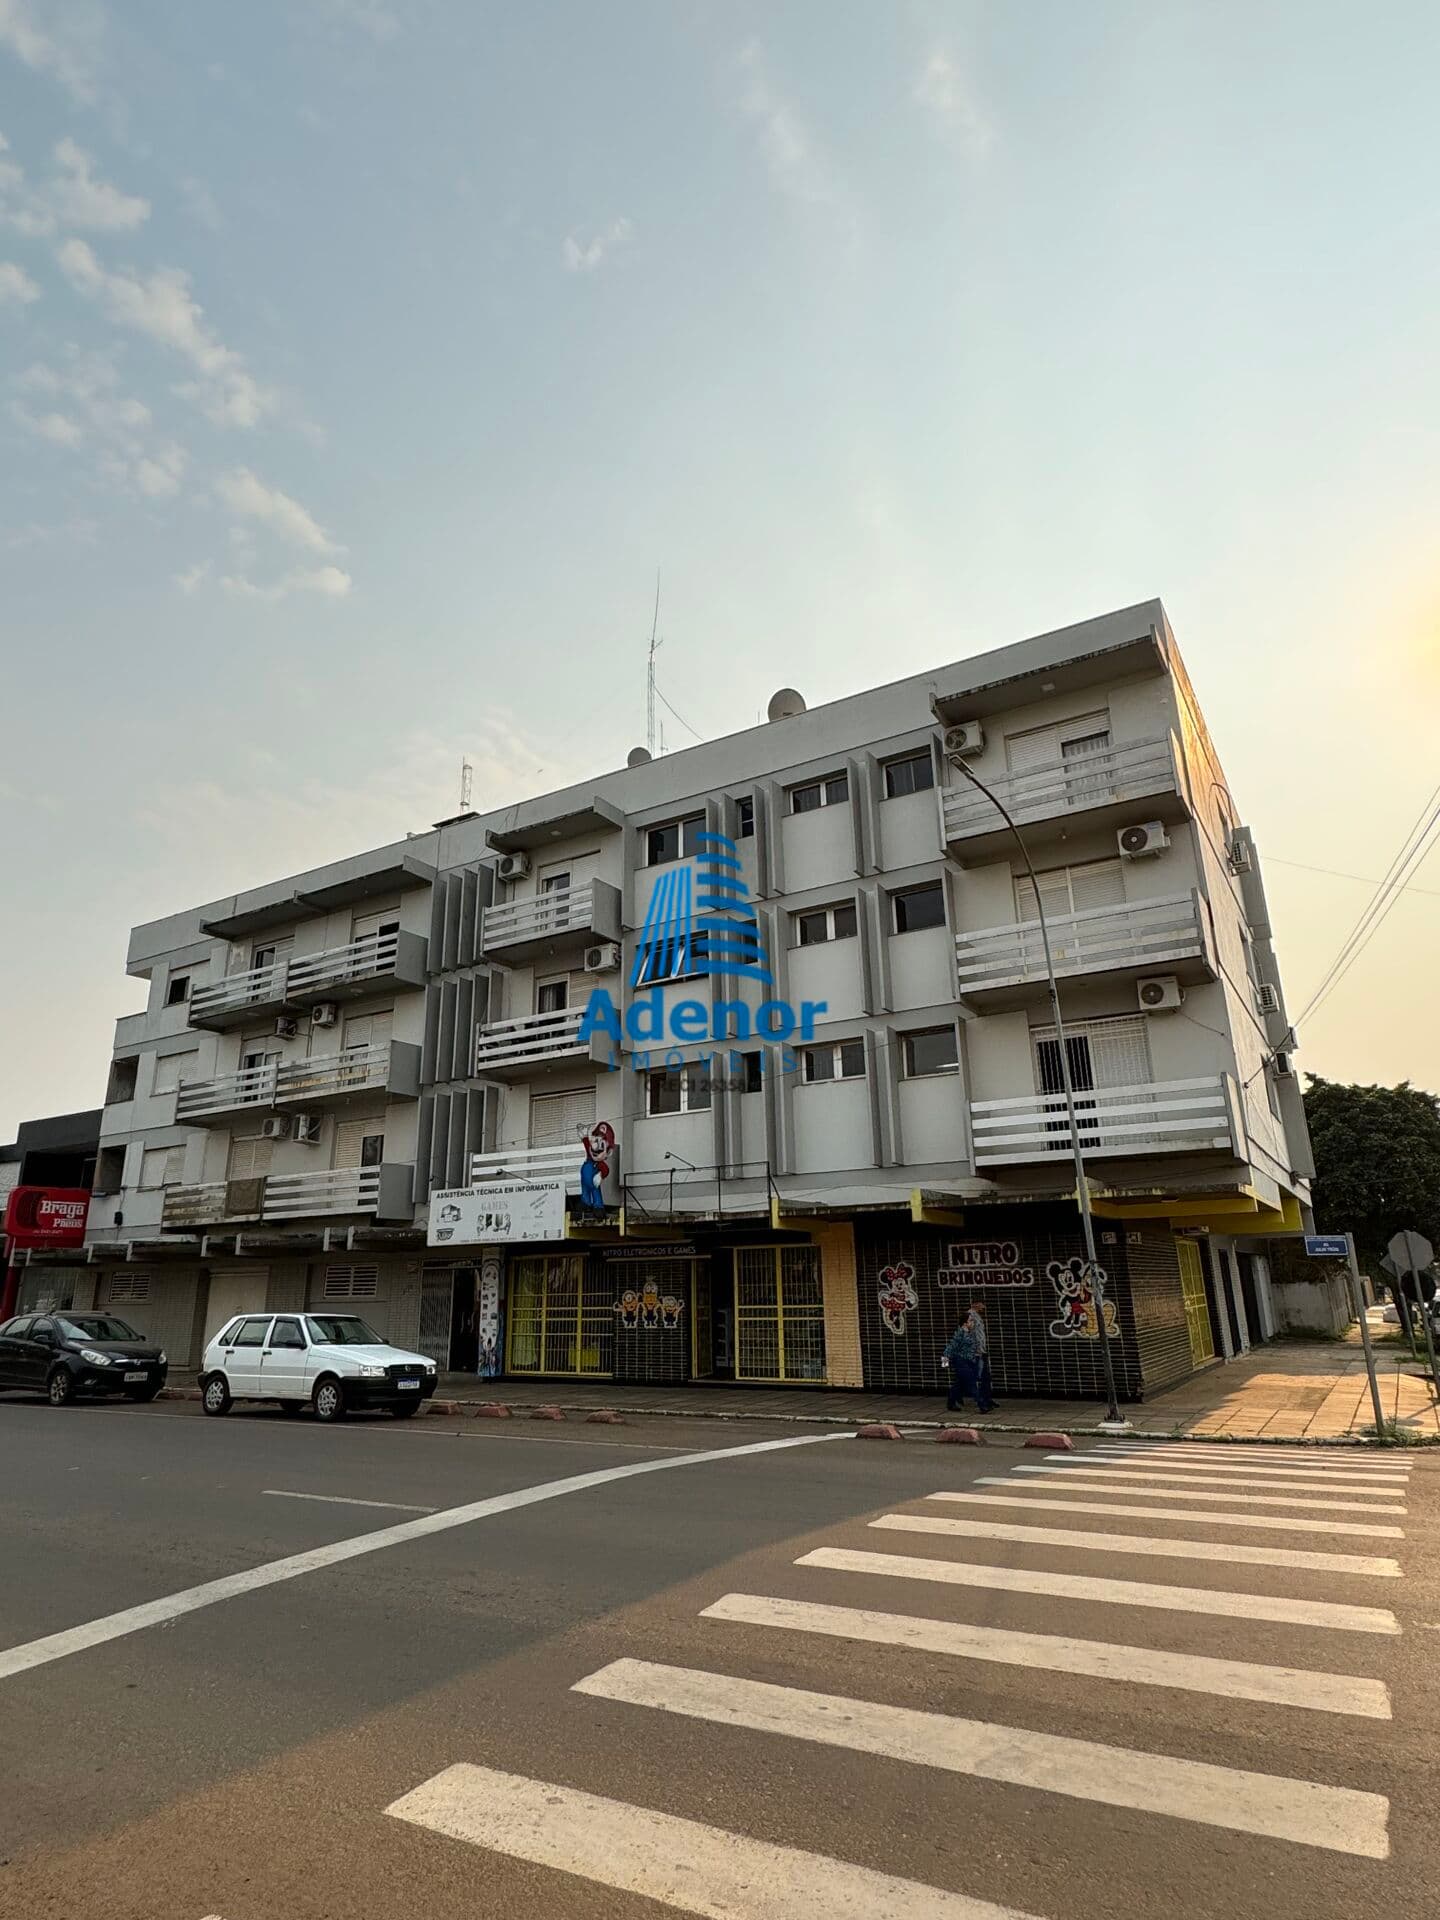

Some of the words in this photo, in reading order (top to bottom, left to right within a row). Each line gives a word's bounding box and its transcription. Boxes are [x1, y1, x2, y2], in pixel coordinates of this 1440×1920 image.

[40, 1200, 84, 1218] Braga
[948, 1242, 1018, 1268] NITRO
[938, 1268, 1034, 1288] BRINQUEDOS
